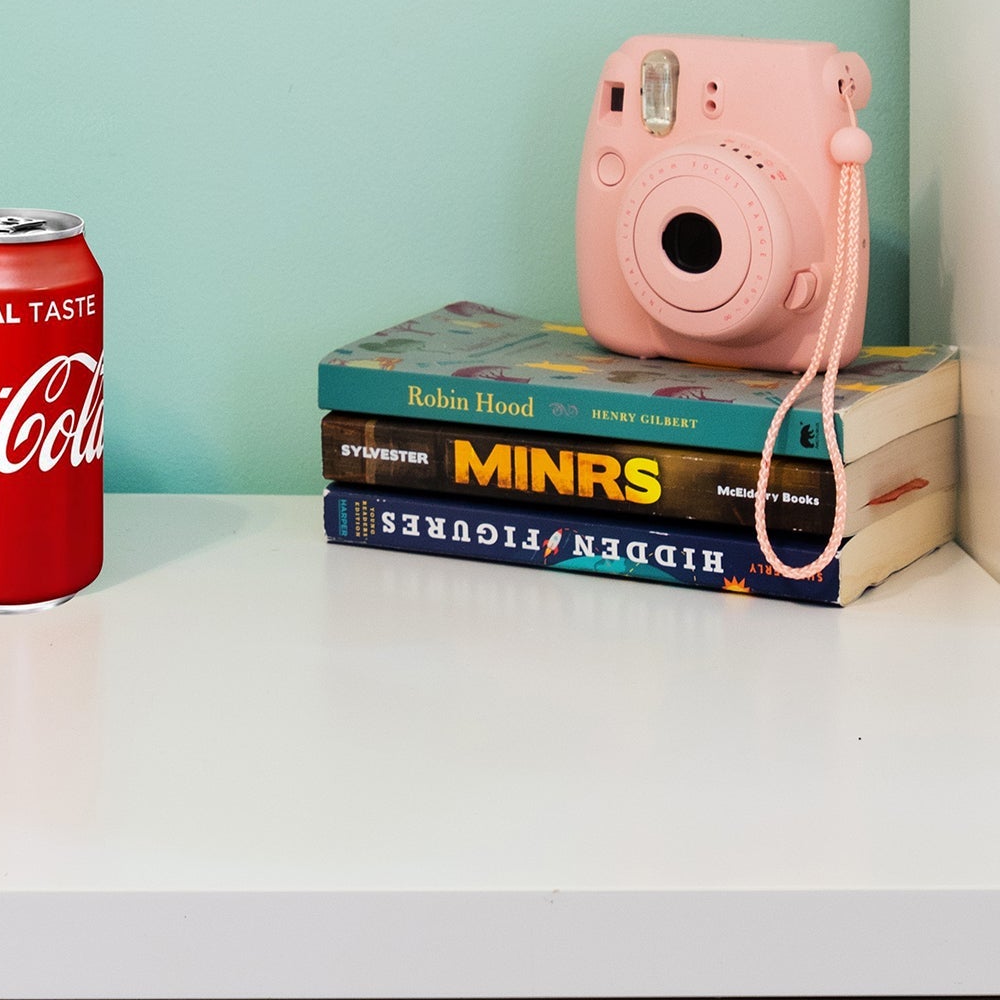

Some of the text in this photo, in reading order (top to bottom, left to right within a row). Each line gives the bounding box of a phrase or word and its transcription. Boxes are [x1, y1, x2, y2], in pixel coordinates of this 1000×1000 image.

[28, 293, 96, 323] TASTE
[408, 385, 535, 418] Robin Hood
[591, 409, 698, 429] HENRY GILBERT
[341, 444, 429, 465] SYLVESTER
[454, 439, 662, 504] MINRS
[782, 492, 820, 506] Books
[339, 499, 348, 537] HARPER
[381, 511, 724, 574] HIDDEN FIGURES
